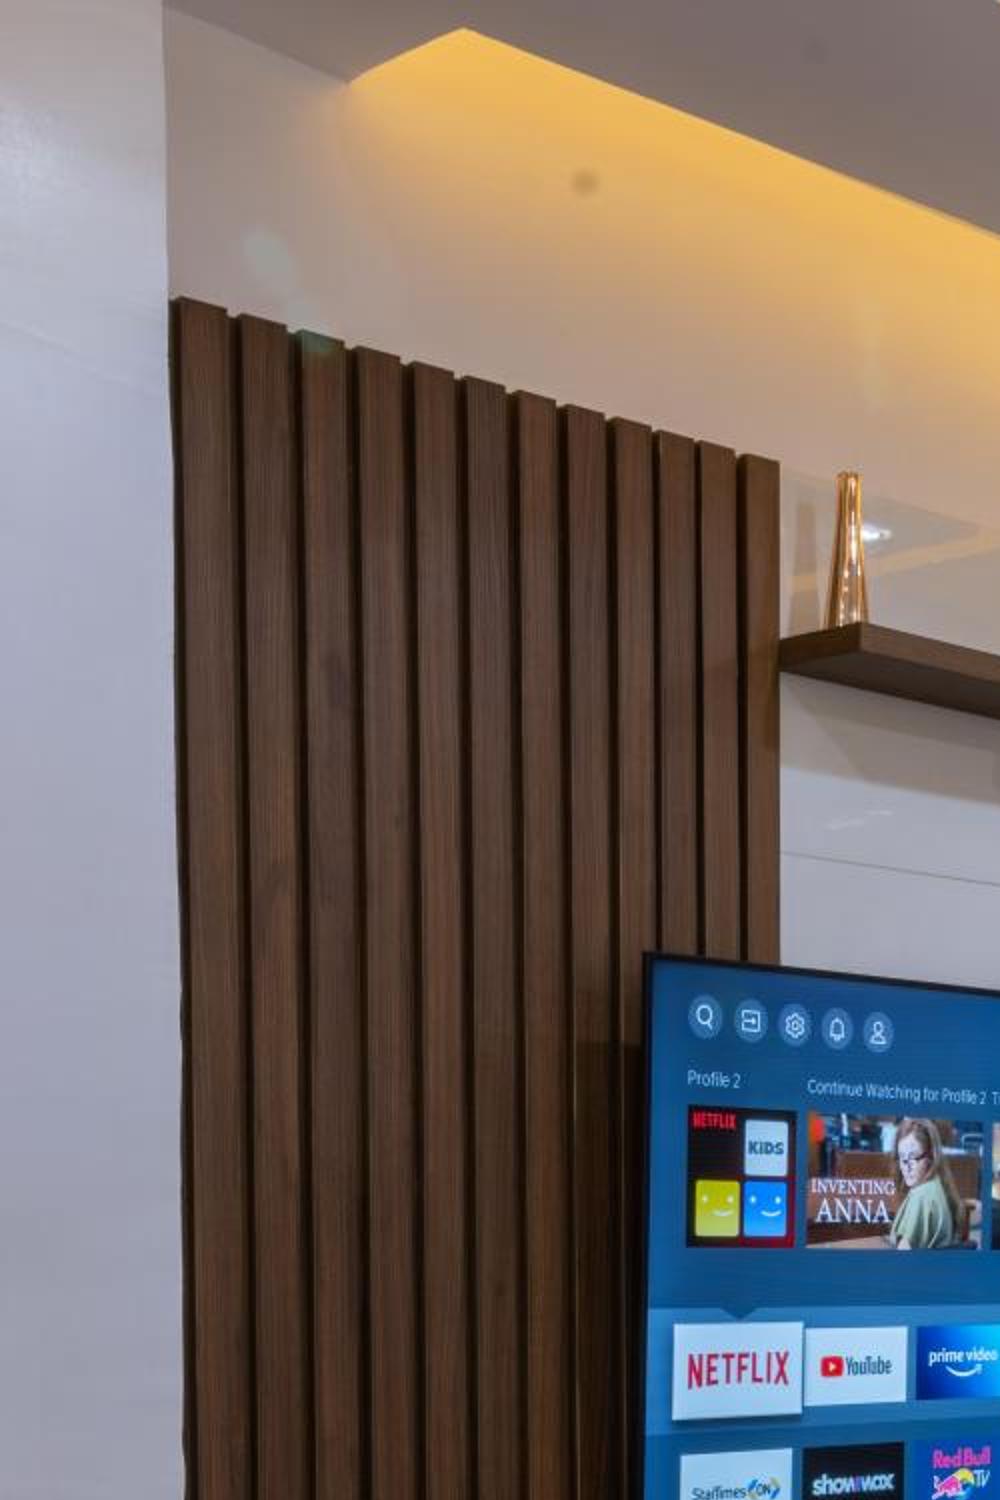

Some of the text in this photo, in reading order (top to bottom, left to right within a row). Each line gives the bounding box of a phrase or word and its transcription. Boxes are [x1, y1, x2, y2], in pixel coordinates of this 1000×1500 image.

[687, 1069, 742, 1089] Profile 2
[807, 1079, 986, 1105] Continue Watching for Profile 2
[693, 1111, 737, 1130] NETFLIX
[811, 1178, 896, 1196] INVENTING
[816, 1200, 890, 1223] ANNA
[846, 1357, 892, 1376] YouTube
[928, 1346, 998, 1367] prime video
[687, 1351, 790, 1389] NETFLIX
[933, 1446, 991, 1468] Red Bull
